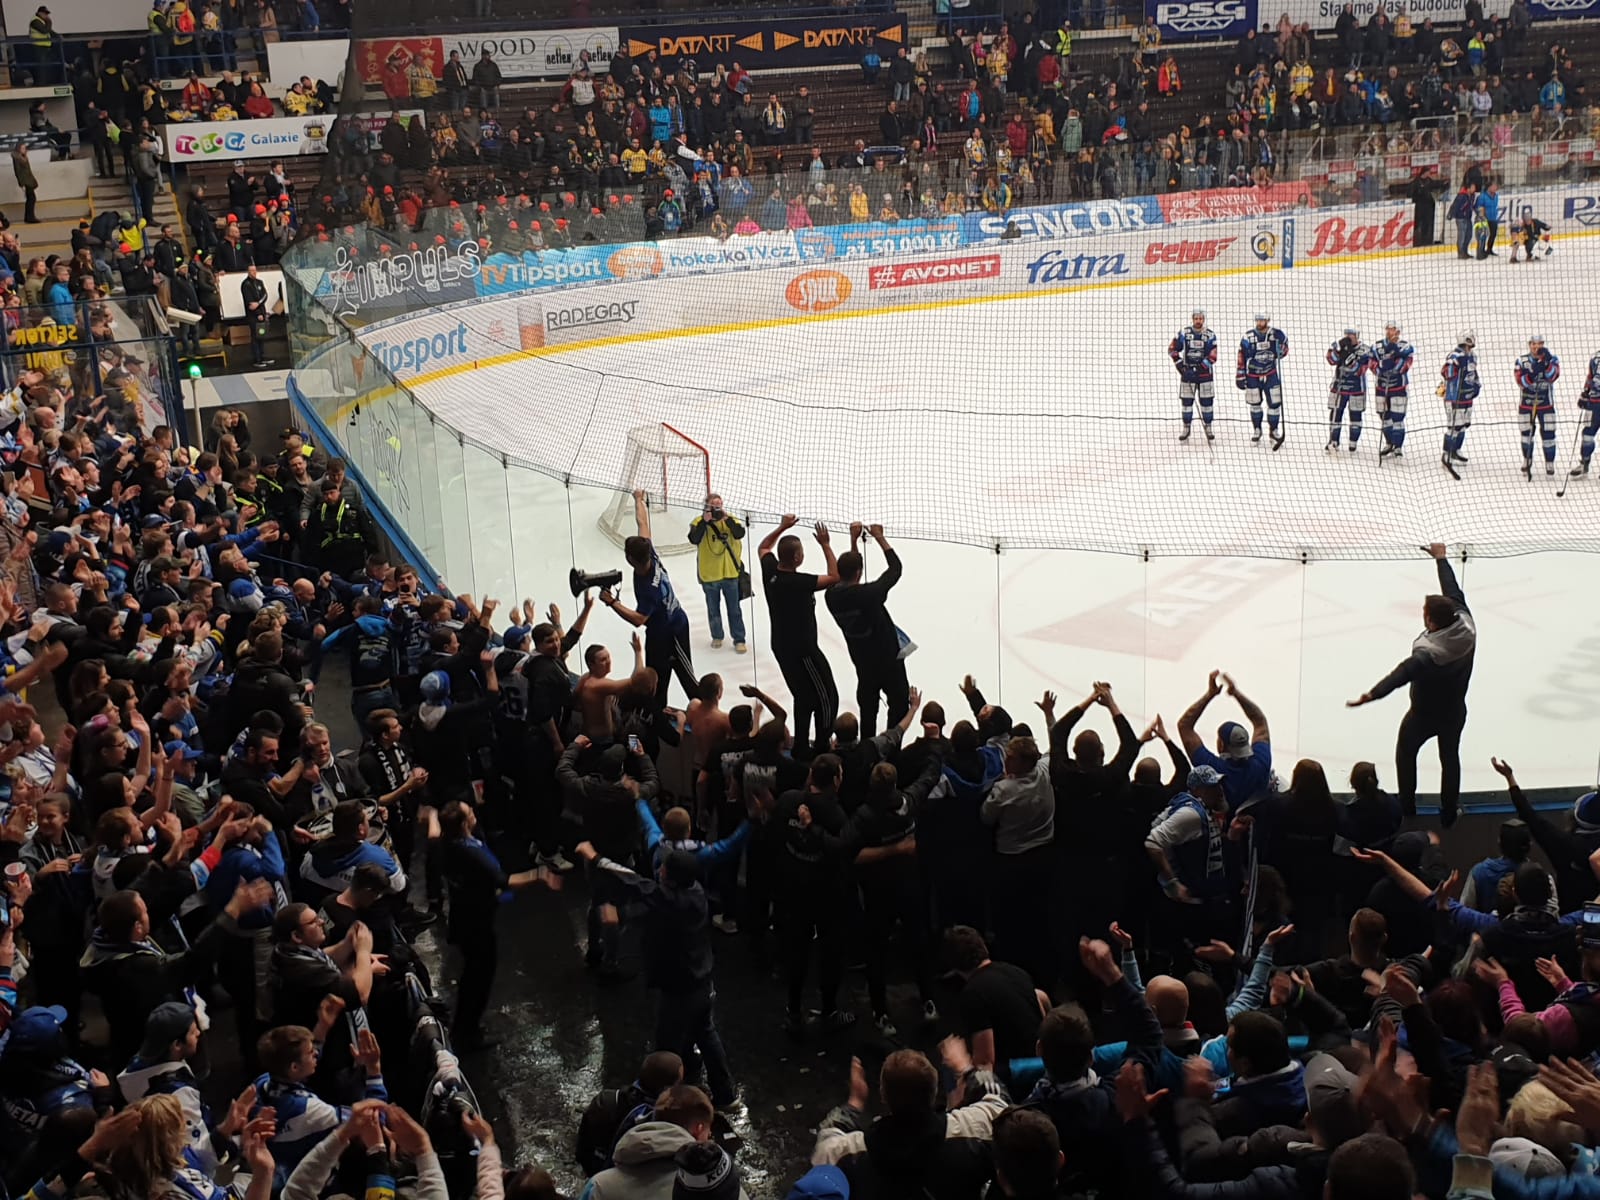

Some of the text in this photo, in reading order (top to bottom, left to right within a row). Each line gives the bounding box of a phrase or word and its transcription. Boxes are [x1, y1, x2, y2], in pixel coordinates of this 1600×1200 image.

[1157, 1, 1246, 24] PSG
[1320, 1, 1374, 17] Stame
[458, 38, 536, 57] WOOD
[660, 35, 736, 55] DATART
[804, 27, 877, 48] DATART
[251, 132, 299, 145] Galaxie
[979, 204, 1147, 239] SENCOR
[358, 241, 481, 303] IMPULS
[901, 260, 996, 281] AVONET
[1026, 250, 1129, 285] fatra
[546, 301, 640, 331] RADEGAST
[371, 322, 468, 373] Tipsport
